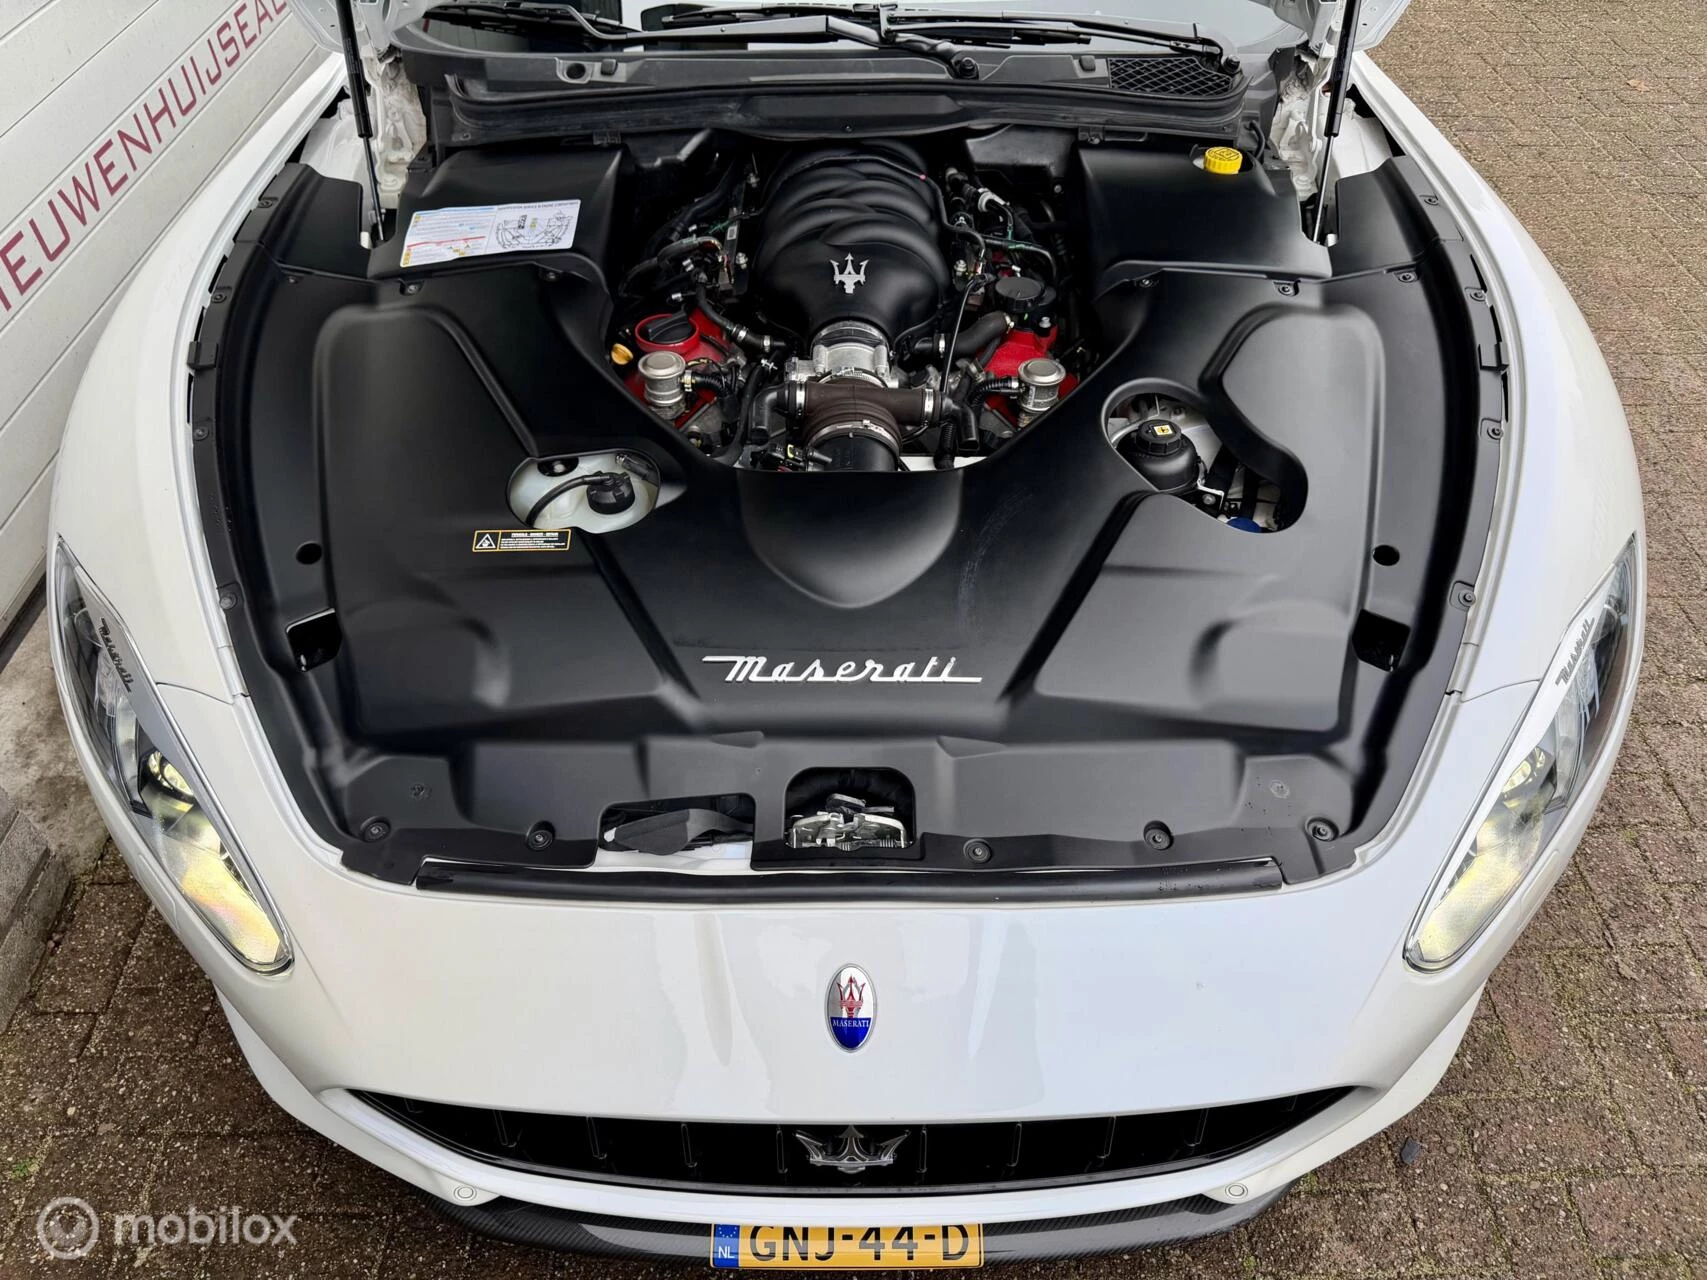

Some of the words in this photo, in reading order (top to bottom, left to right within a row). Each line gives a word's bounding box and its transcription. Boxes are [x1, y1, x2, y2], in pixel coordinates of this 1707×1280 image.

[701, 655, 984, 683] Maserati
[832, 1019, 870, 1028] MASERATI
[718, 1245, 735, 1259] NL
[749, 1224, 970, 1262] GNJ-44-D
